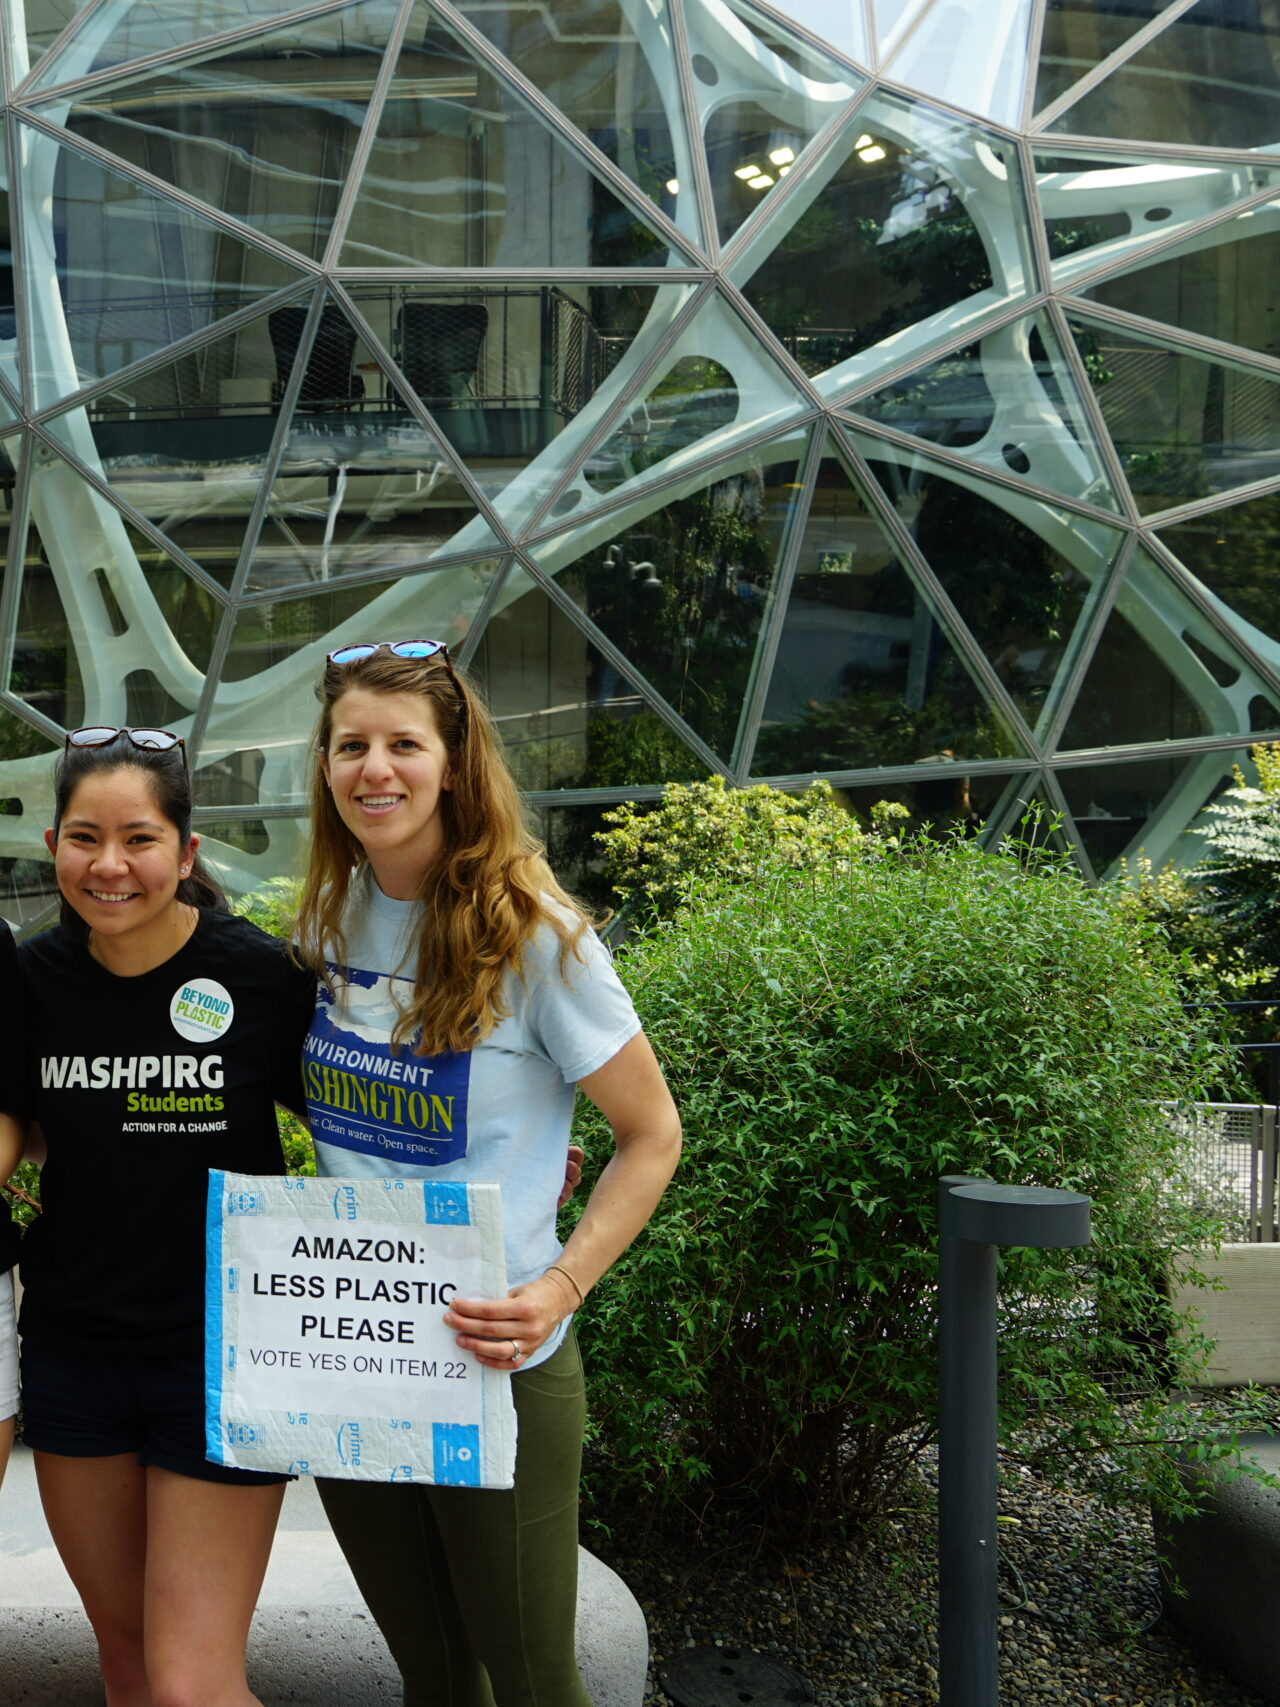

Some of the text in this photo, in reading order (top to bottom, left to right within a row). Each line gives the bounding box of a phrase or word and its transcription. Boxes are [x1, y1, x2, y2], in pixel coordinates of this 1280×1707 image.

[175, 1000, 225, 1030] PLASTIC
[181, 987, 230, 1015] BEYOND
[41, 1054, 224, 1089] WASHPIRG
[127, 1091, 224, 1112] Students
[122, 1120, 228, 1132] ACTION FOR A CHANGE
[321, 1117, 346, 1136] Clean
[348, 1128, 375, 1143] water.
[377, 1133, 404, 1151] Open
[406, 1142, 439, 1157] space.
[342, 1186, 358, 1220] prim
[291, 1236, 425, 1264] AMAZON:
[253, 1273, 325, 1298] LESS
[335, 1277, 457, 1306] PLASTIC
[300, 1315, 415, 1344] PLEASE
[249, 1349, 302, 1368] VOTE
[308, 1353, 347, 1371] YES
[353, 1355, 383, 1374] ON
[390, 1357, 437, 1378] ITEM
[443, 1362, 467, 1379] 22
[347, 1422, 363, 1467] prime
